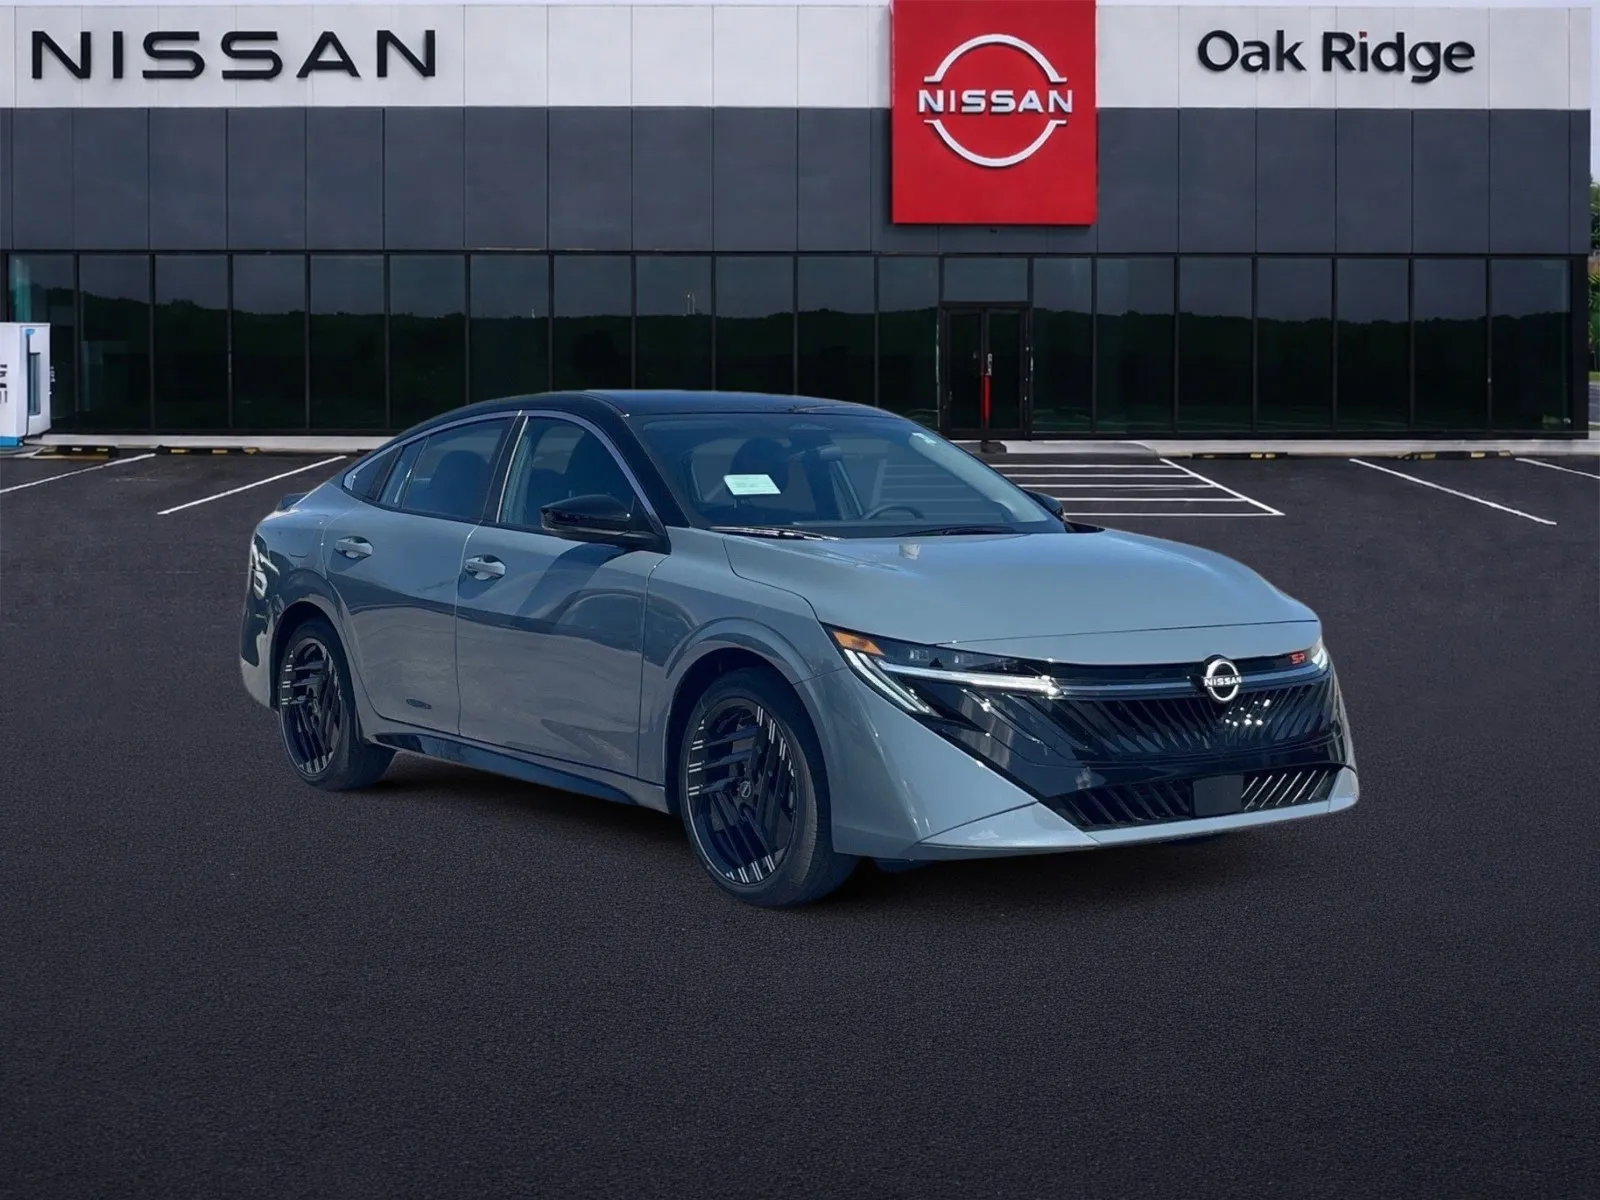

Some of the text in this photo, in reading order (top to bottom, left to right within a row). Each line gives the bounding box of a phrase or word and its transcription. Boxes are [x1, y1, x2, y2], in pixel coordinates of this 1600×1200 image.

[32, 30, 436, 80] NISSAN
[1198, 30, 1476, 84] Oak Ridge
[918, 89, 1073, 114] NISSAN
[1290, 653, 1306, 664] SR
[1203, 676, 1242, 687] NISSAN
